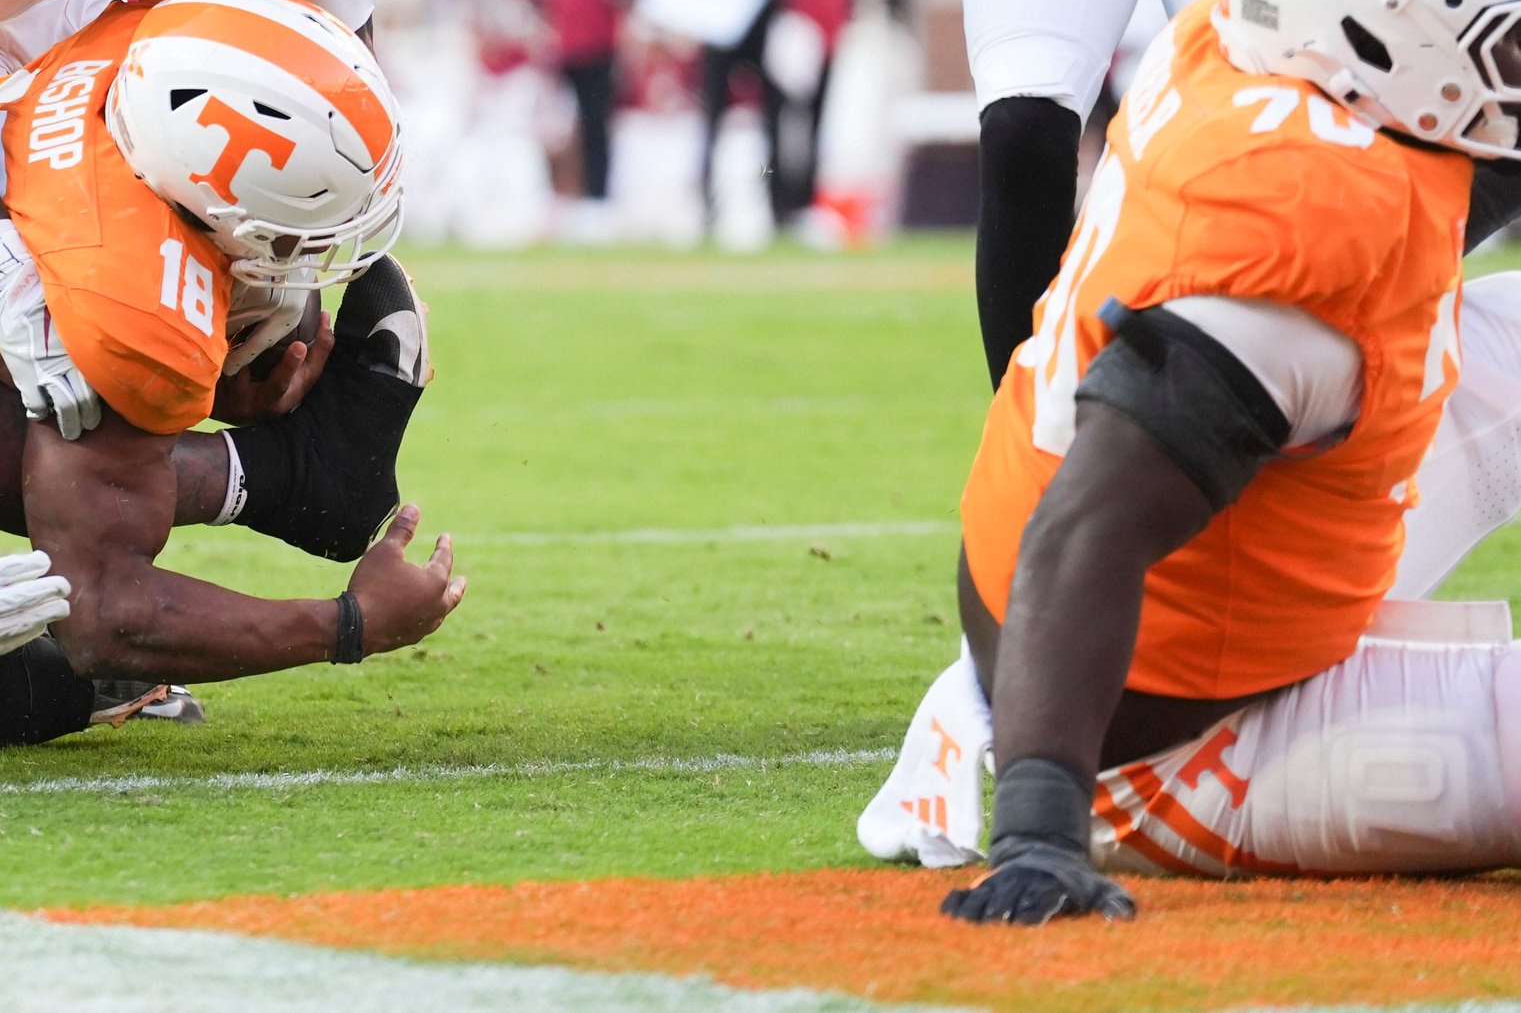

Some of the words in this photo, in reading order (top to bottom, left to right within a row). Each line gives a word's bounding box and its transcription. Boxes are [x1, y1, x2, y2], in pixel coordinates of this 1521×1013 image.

[28, 59, 114, 171] BISHOP
[189, 95, 297, 206] T
[160, 238, 214, 338] 18
[930, 717, 962, 782] T
[1177, 727, 1251, 811] T
